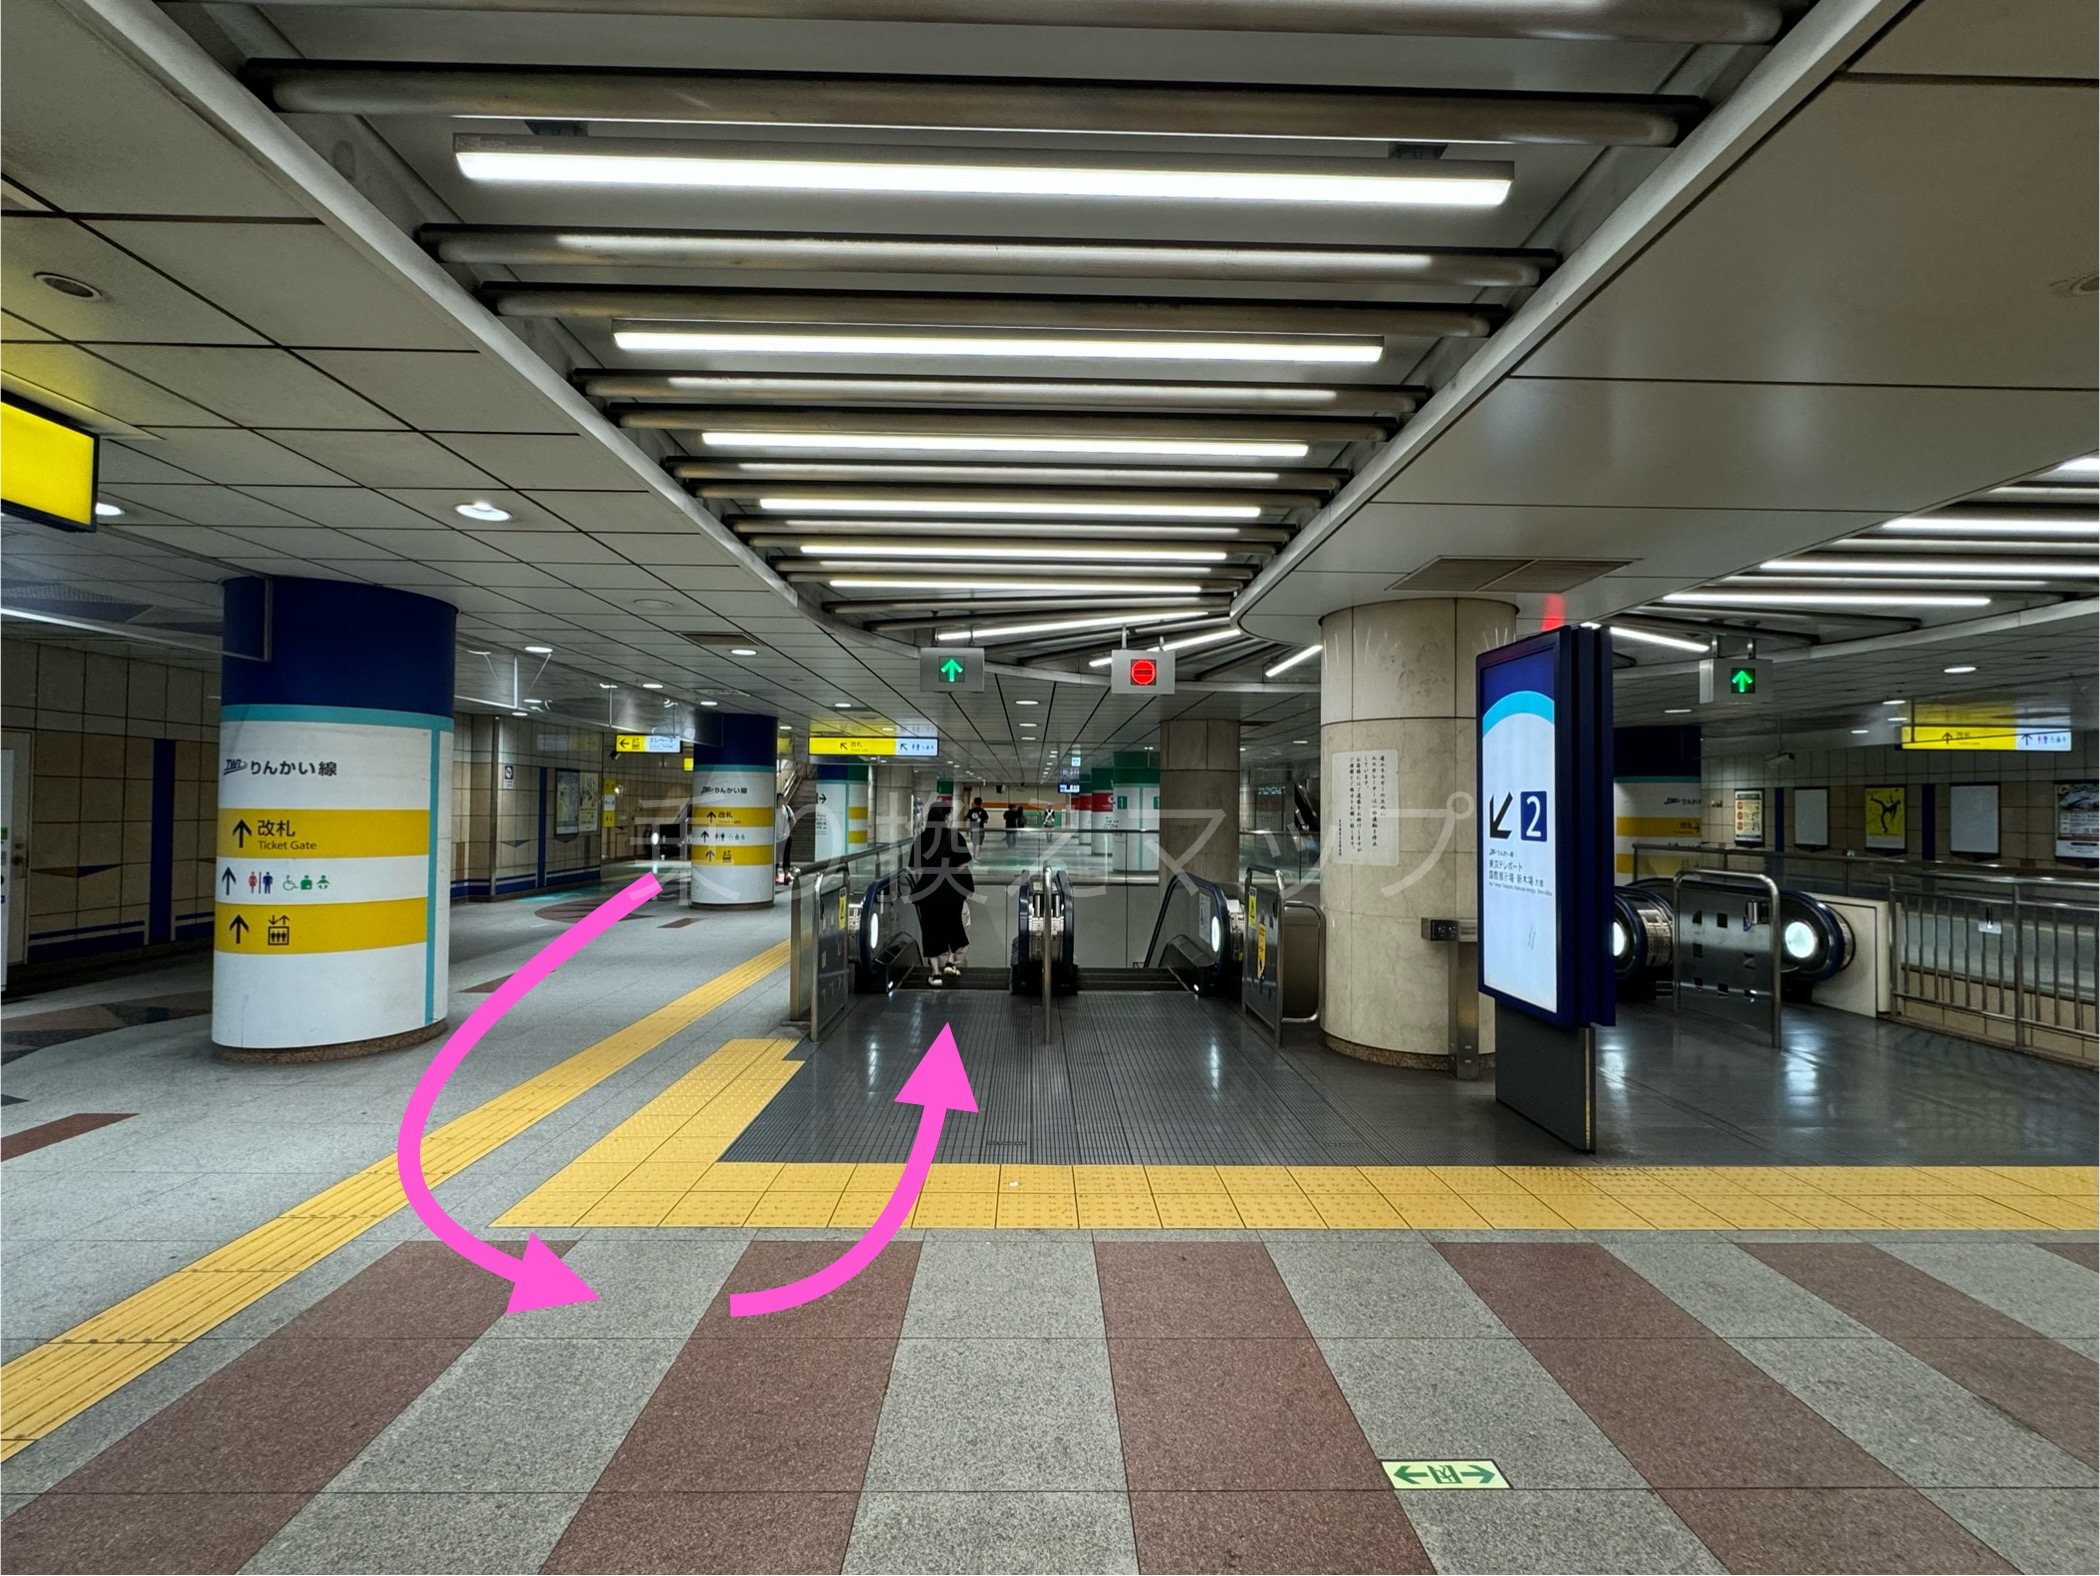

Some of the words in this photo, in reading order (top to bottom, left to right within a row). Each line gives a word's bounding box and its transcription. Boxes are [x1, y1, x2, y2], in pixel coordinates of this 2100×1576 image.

[250, 760, 338, 776] りんかい線
[718, 810, 733, 819] 改札
[1526, 795, 1542, 838] 2
[257, 819, 296, 837] 改札
[258, 840, 288, 850] Ticket
[290, 840, 317, 851] Gate
[1489, 859, 1523, 872] 東京テレポート
